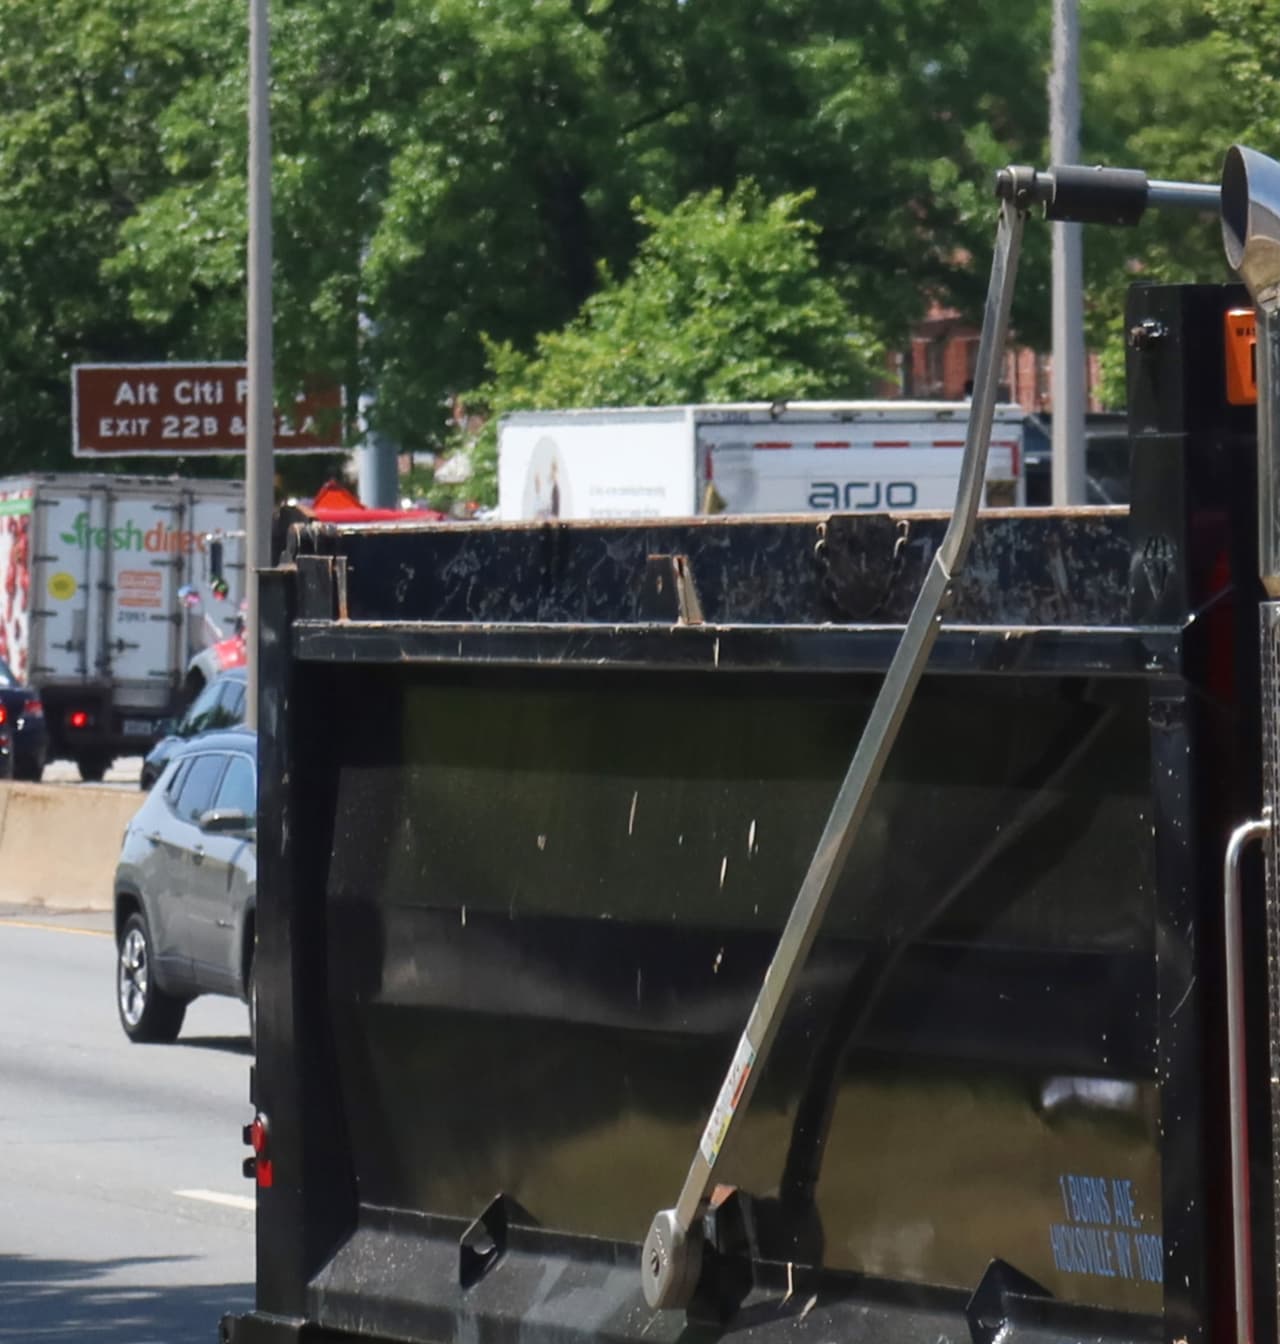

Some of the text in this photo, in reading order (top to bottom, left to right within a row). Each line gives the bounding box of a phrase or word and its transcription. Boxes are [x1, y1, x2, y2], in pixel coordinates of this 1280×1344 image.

[114, 380, 159, 406] Alt
[173, 379, 224, 405] Citi
[99, 417, 149, 437] EXIT
[161, 415, 218, 440] 22B
[72, 511, 222, 553] freshdirec
[1060, 1175, 1071, 1222] 1
[1067, 1174, 1113, 1225] BURNS
[1050, 1224, 1164, 1284] HICKSVILLE NY 1180
